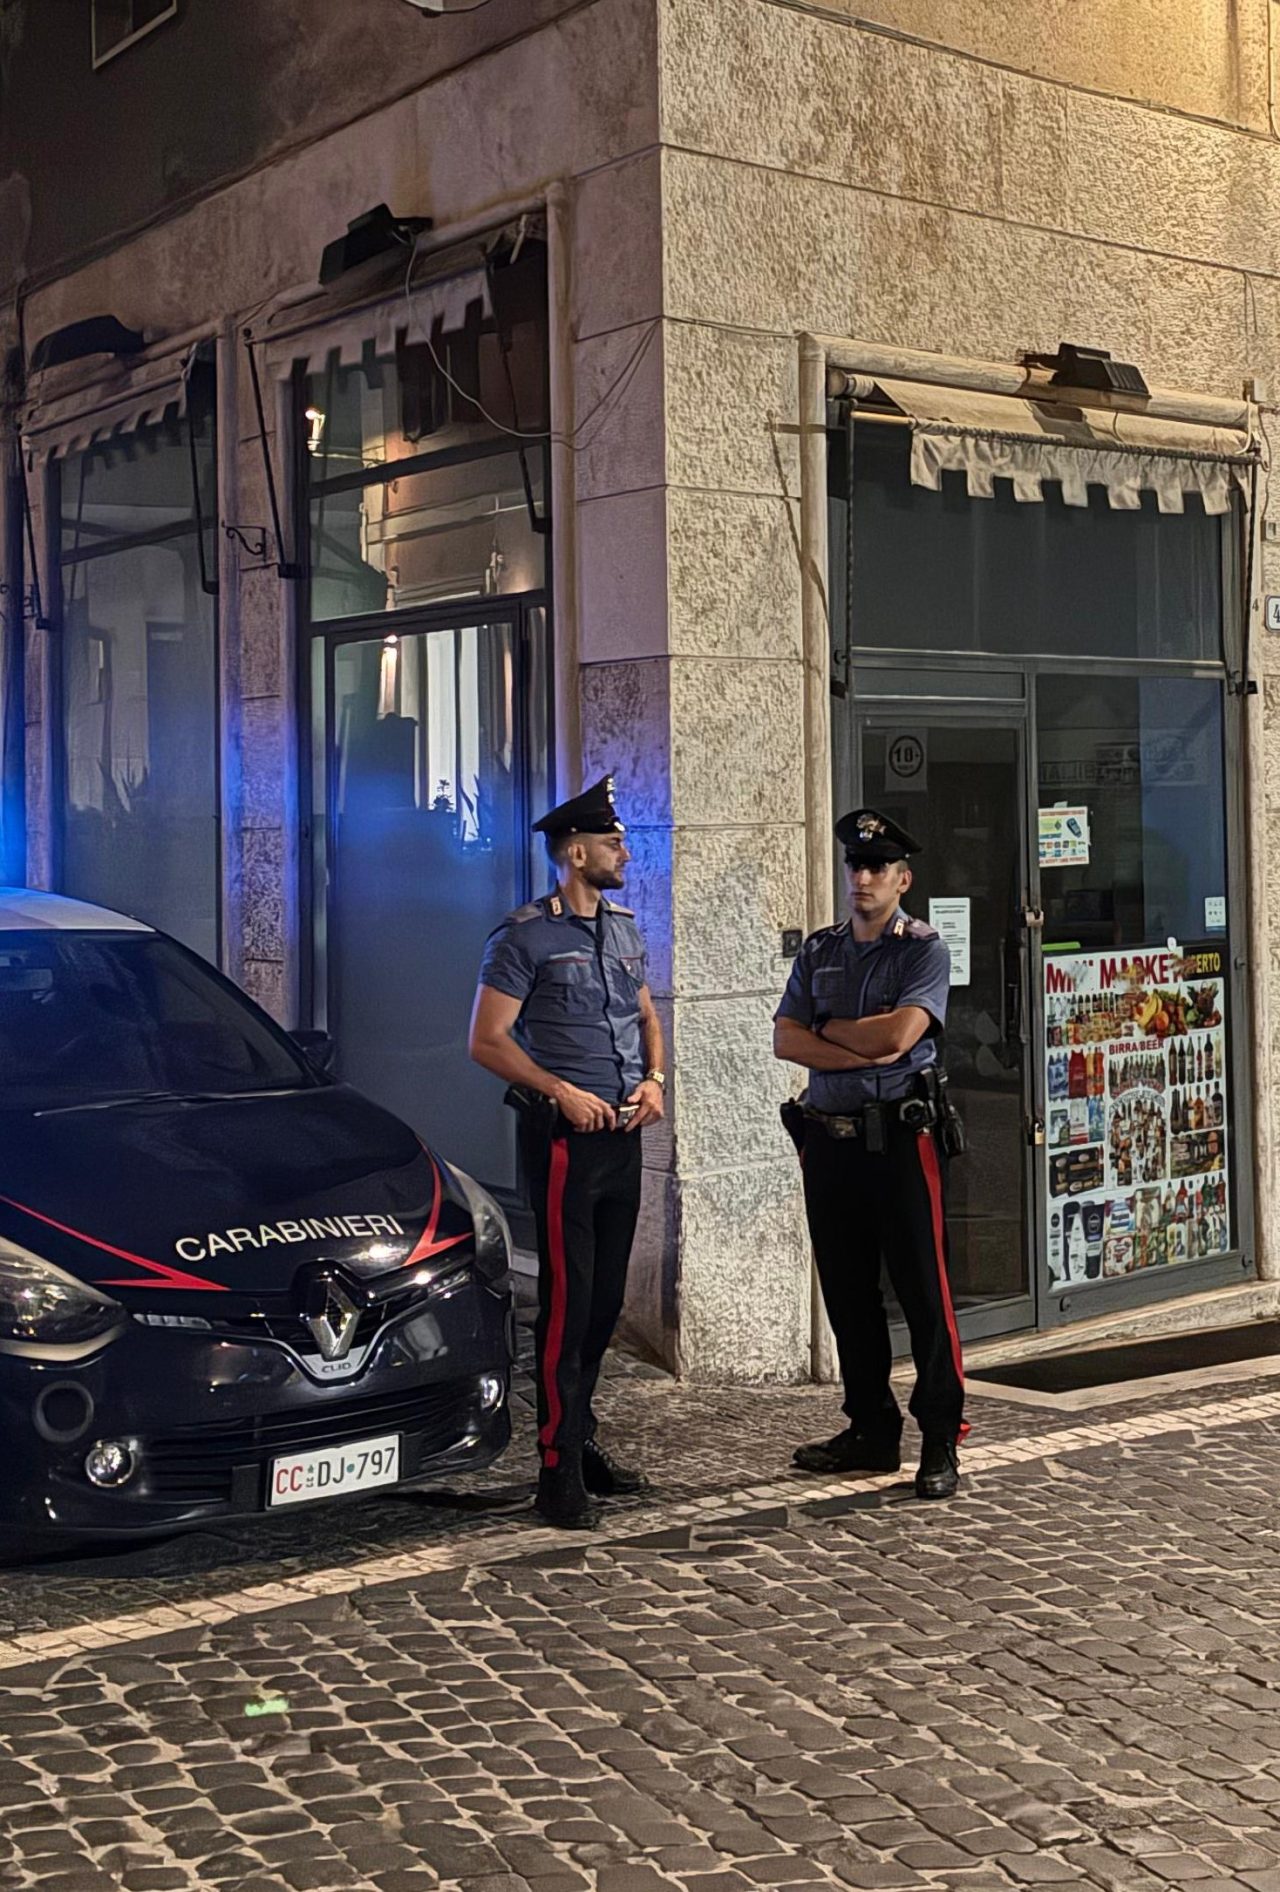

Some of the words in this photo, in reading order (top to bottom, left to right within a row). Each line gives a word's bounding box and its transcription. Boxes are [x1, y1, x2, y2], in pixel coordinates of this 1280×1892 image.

[175, 1214, 404, 1262] CARABINIERI
[321, 1362, 352, 1374] CLIO
[275, 1465, 304, 1495] CC
[317, 1456, 345, 1488] DJ
[356, 1446, 396, 1481] 797
